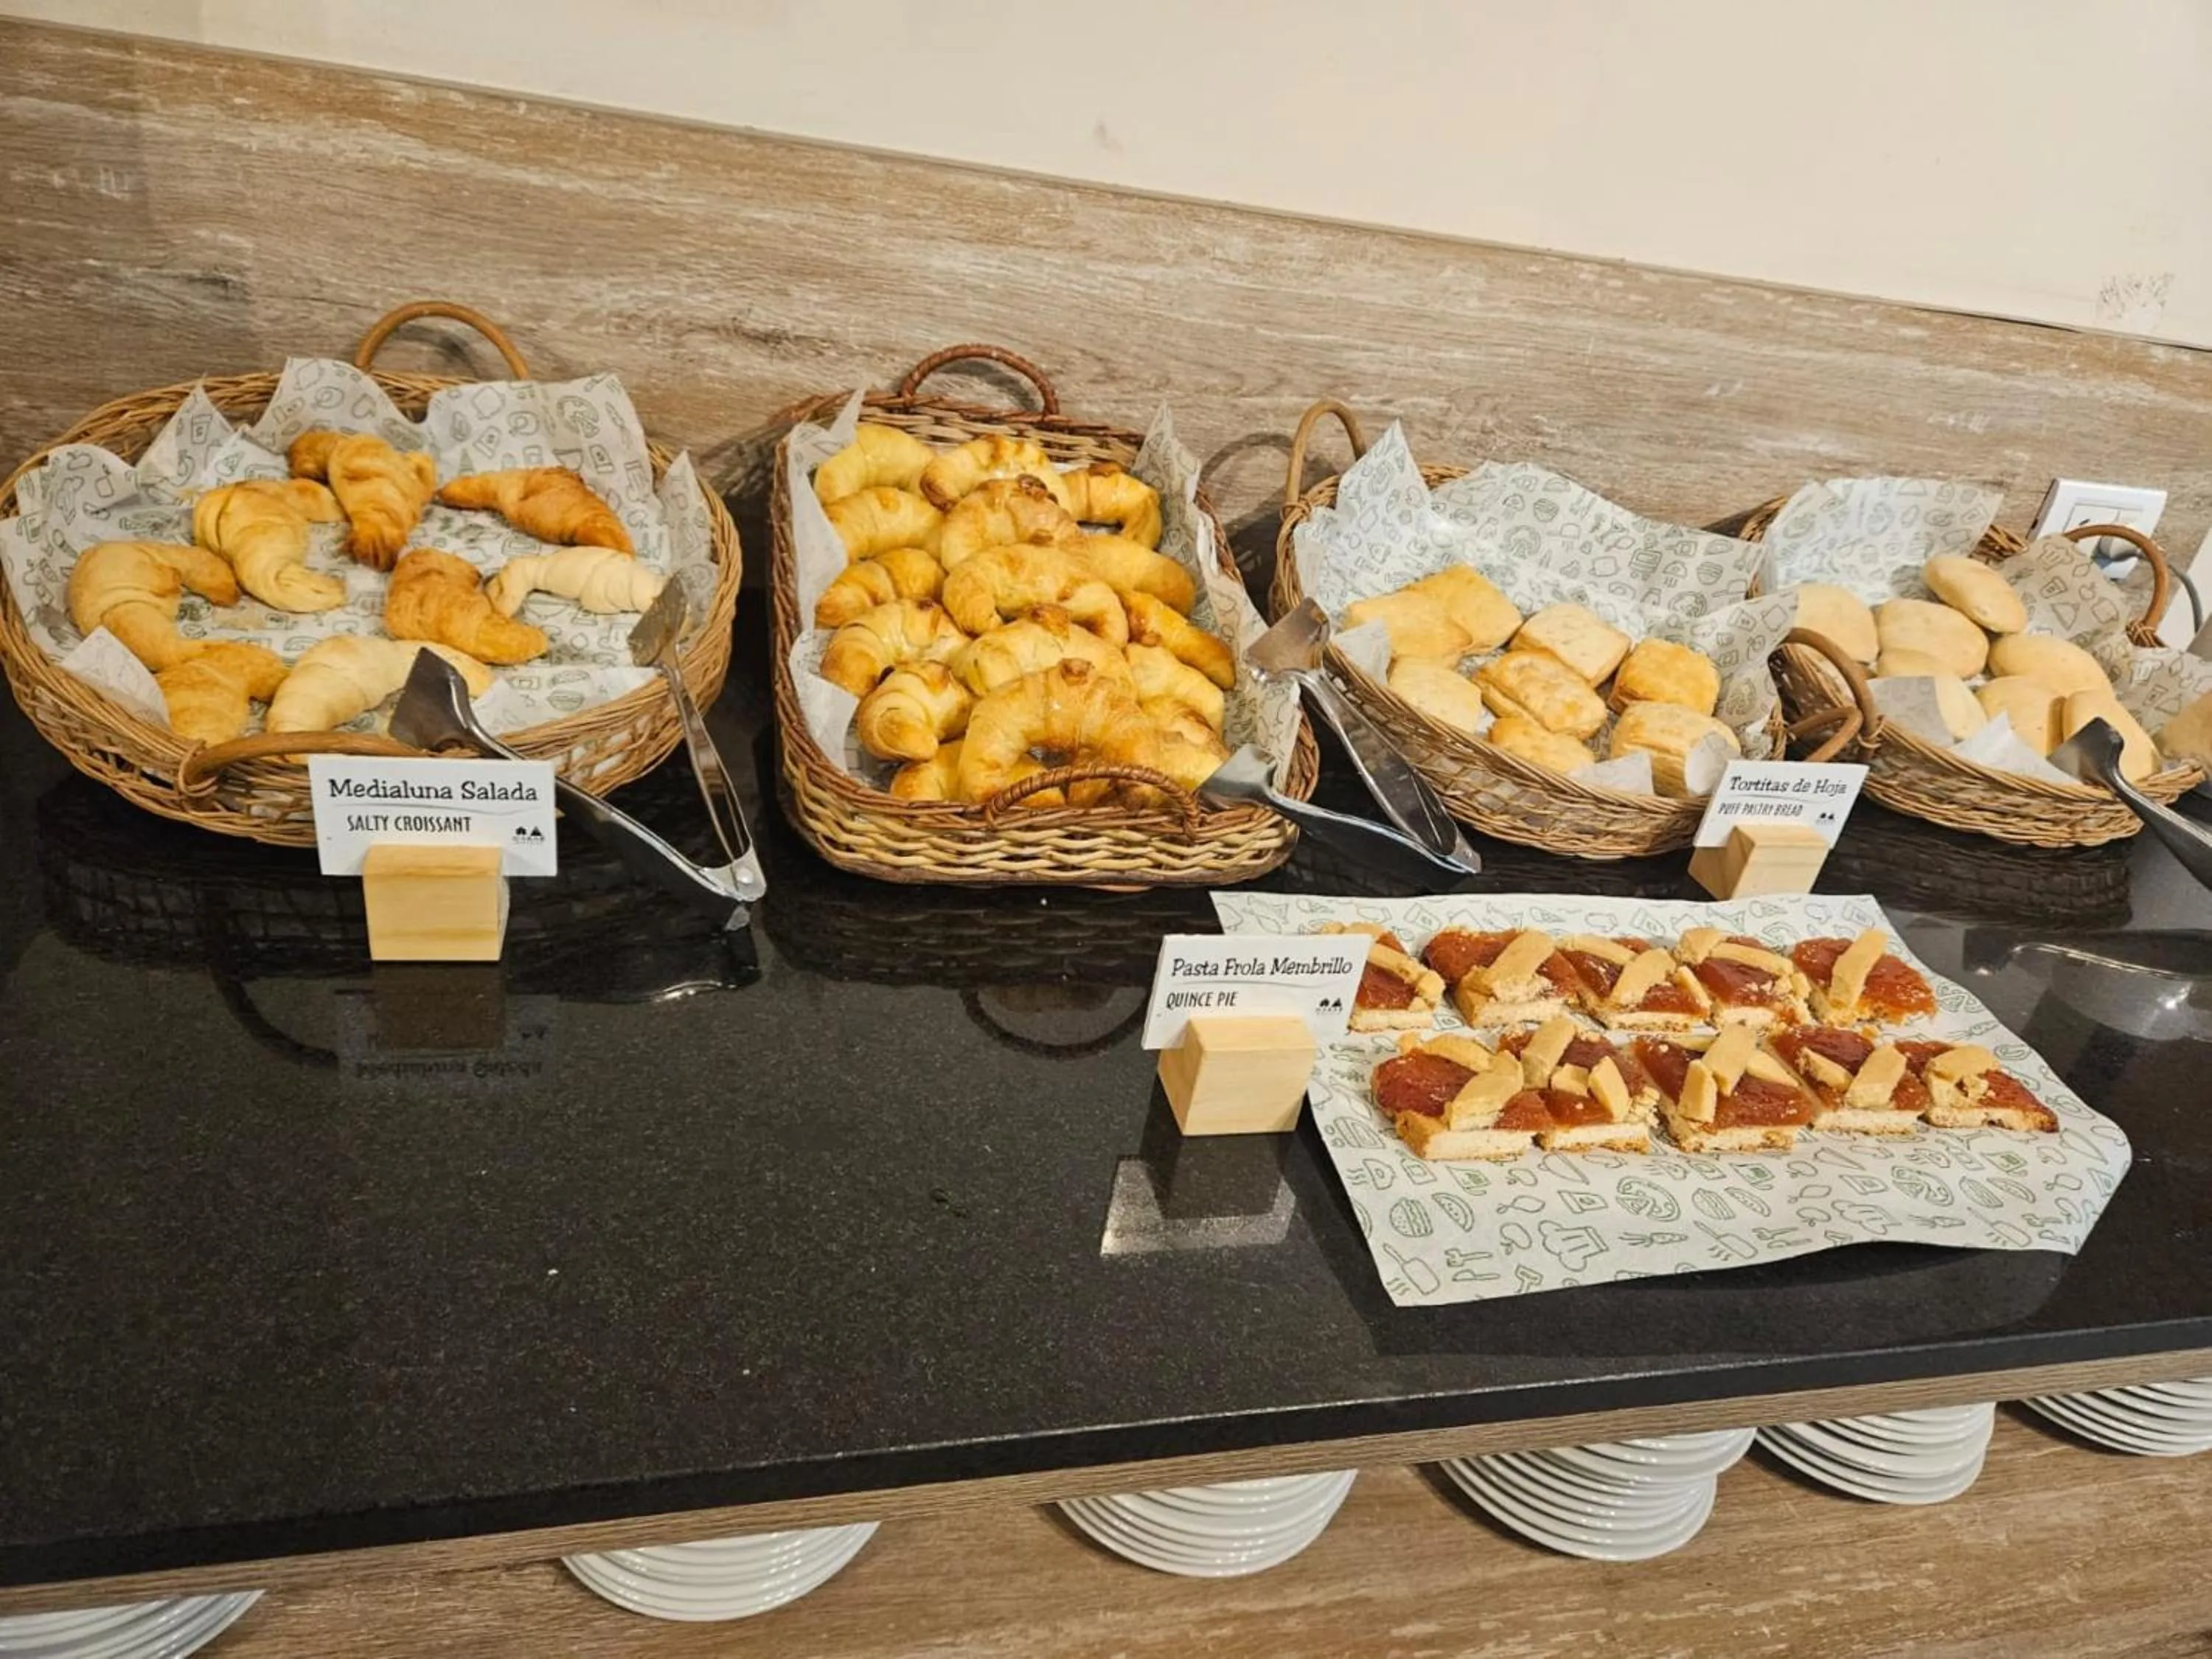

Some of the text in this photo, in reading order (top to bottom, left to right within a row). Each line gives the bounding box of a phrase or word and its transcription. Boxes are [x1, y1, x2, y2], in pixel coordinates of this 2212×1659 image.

[329, 779, 538, 801] Medialuna Salada
[1730, 776, 1847, 797] Tortitas de Hoja
[1774, 804, 1804, 816] BREAD
[348, 815, 472, 832] SALTY CROISSANT
[1172, 957, 1353, 977] Pasta Frola Membrillo
[1166, 991, 1239, 1009] QUINCE PIE
